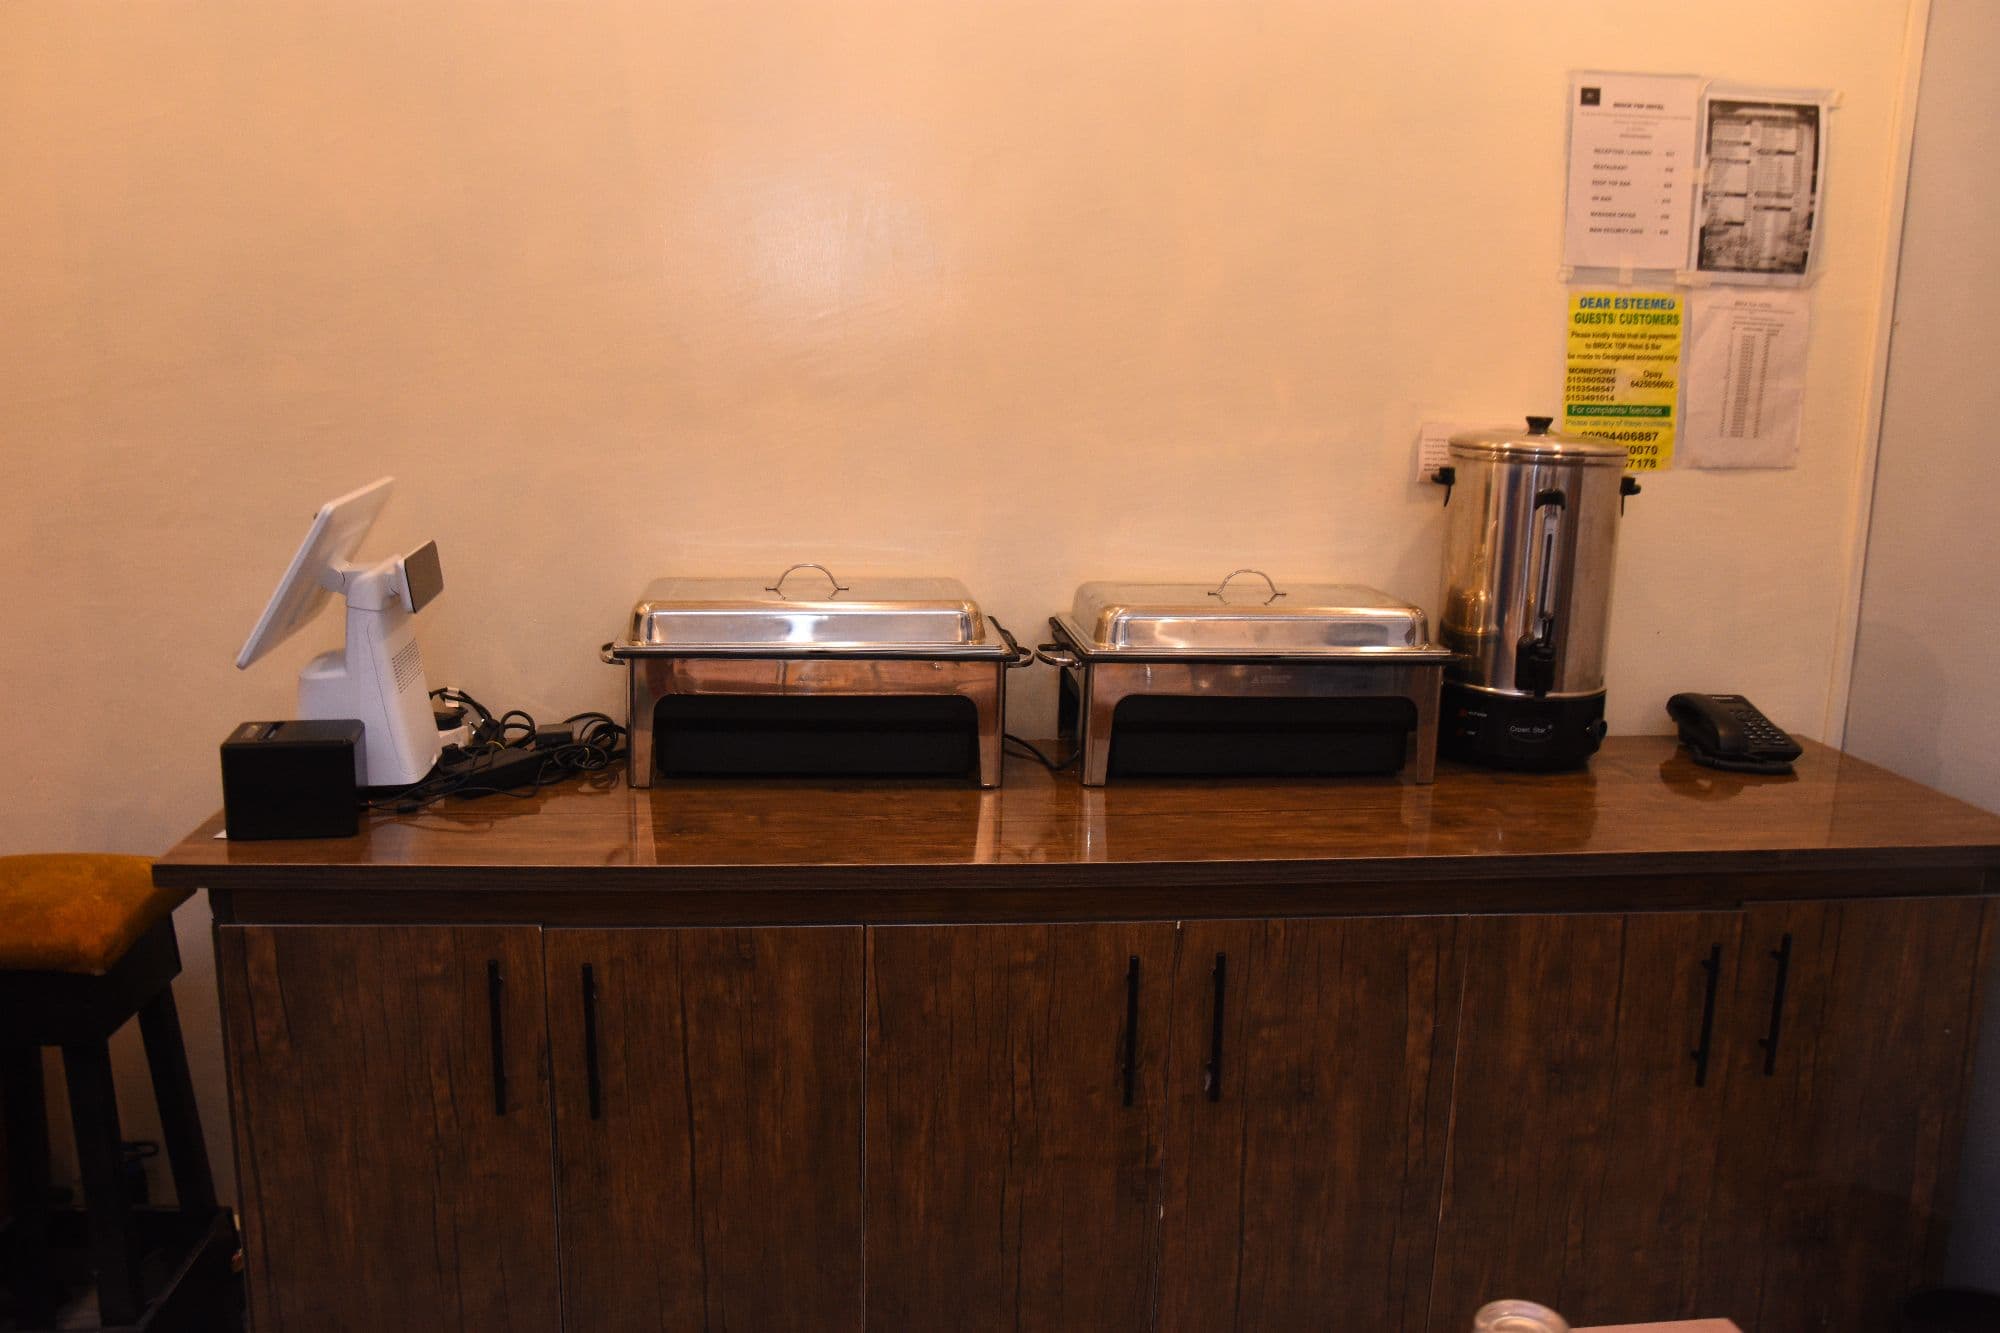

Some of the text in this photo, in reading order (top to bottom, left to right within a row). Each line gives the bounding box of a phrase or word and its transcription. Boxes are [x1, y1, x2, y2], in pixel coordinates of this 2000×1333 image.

[1579, 297, 1676, 310] DEAR ESTEEMED
[1619, 314, 1680, 326] CUSTOMERS
[1648, 333, 1677, 342] payments
[1602, 353, 1636, 362] Designated
[1664, 354, 1678, 363] only
[1642, 370, 1664, 380] Opay
[1571, 406, 1584, 414] For
[1628, 406, 1663, 416] feedback
[1602, 420, 1615, 428] any
[1533, 725, 1546, 734] Star
